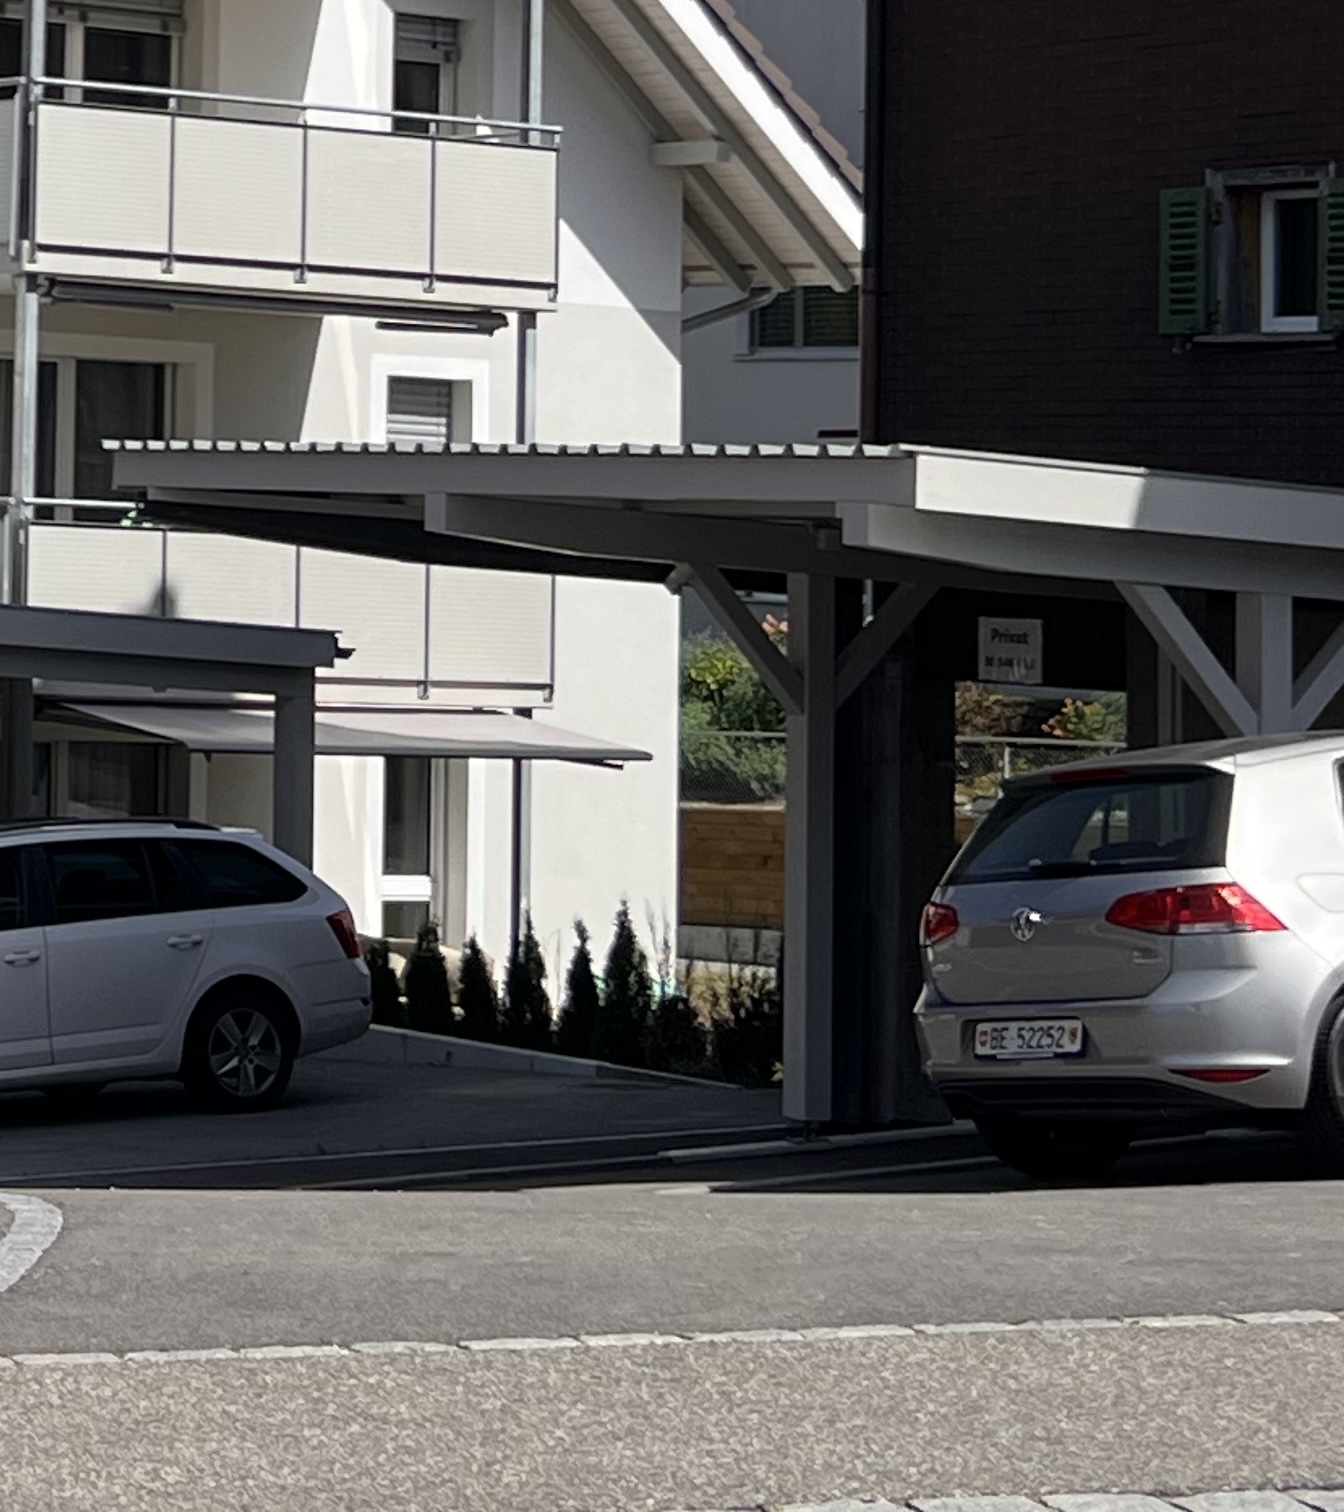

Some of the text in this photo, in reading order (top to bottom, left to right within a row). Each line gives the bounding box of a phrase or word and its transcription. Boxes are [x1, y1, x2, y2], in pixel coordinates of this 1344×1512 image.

[991, 628, 1029, 644] Privat
[990, 1025, 1065, 1050] BE 52252
